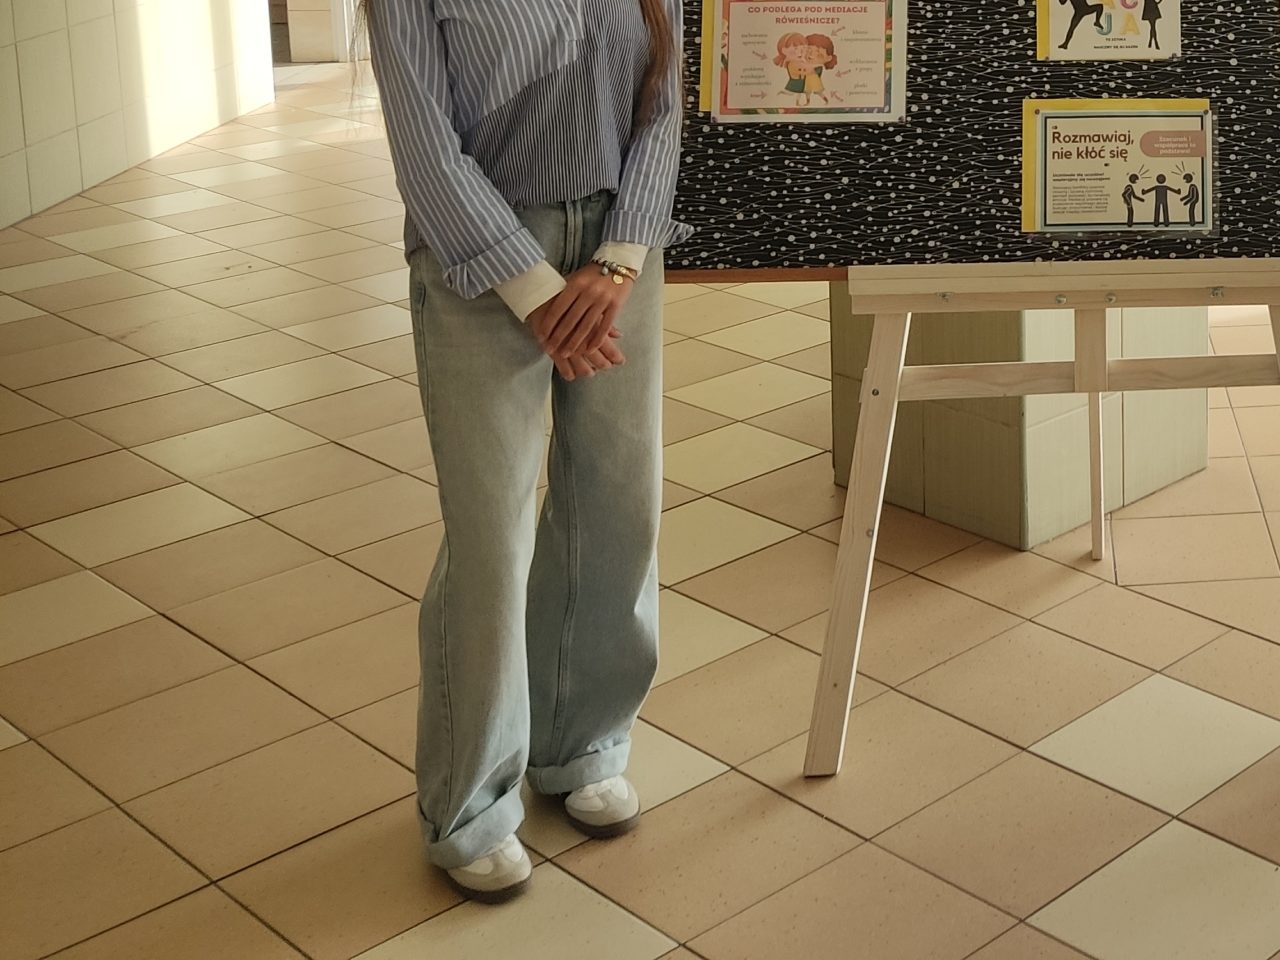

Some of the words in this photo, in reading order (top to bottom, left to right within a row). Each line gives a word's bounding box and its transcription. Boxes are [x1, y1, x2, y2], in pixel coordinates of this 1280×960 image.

[747, 6, 760, 14] CO
[762, 6, 802, 14] PODLEGA
[825, 6, 869, 14] MEDIACJE
[775, 15, 840, 25] RÓWIEŚNICZE?
[1052, 130, 1134, 146] Rozmawiaj,
[1051, 148, 1073, 160] nie
[1076, 145, 1107, 160] kłóć
[1109, 147, 1129, 162] się
